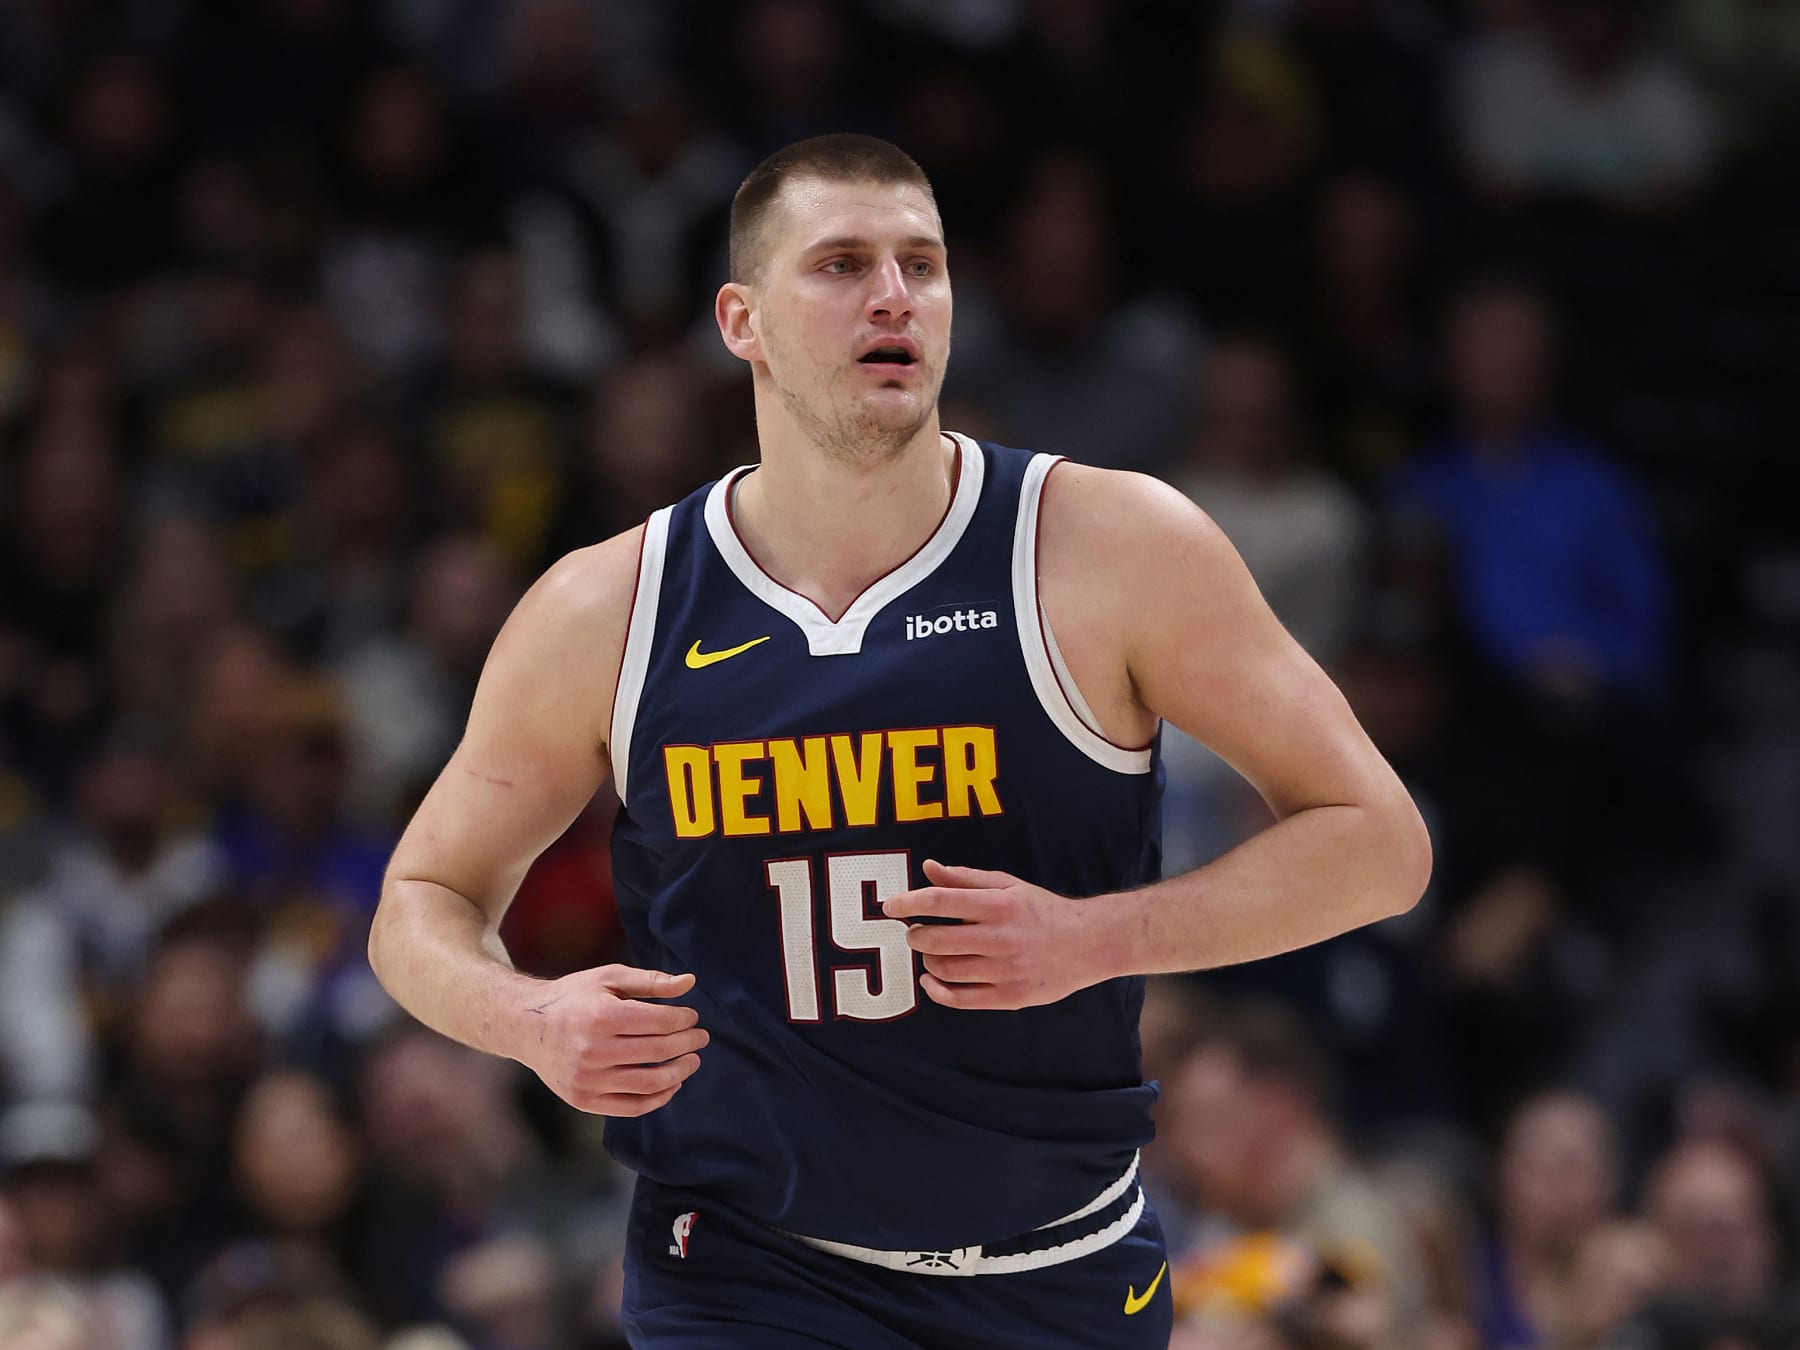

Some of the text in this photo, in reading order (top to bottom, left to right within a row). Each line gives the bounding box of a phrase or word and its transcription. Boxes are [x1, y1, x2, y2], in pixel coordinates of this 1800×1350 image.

[906, 609, 998, 640] ibotta
[664, 725, 1004, 839] DENVER
[764, 849, 918, 1023] 15
